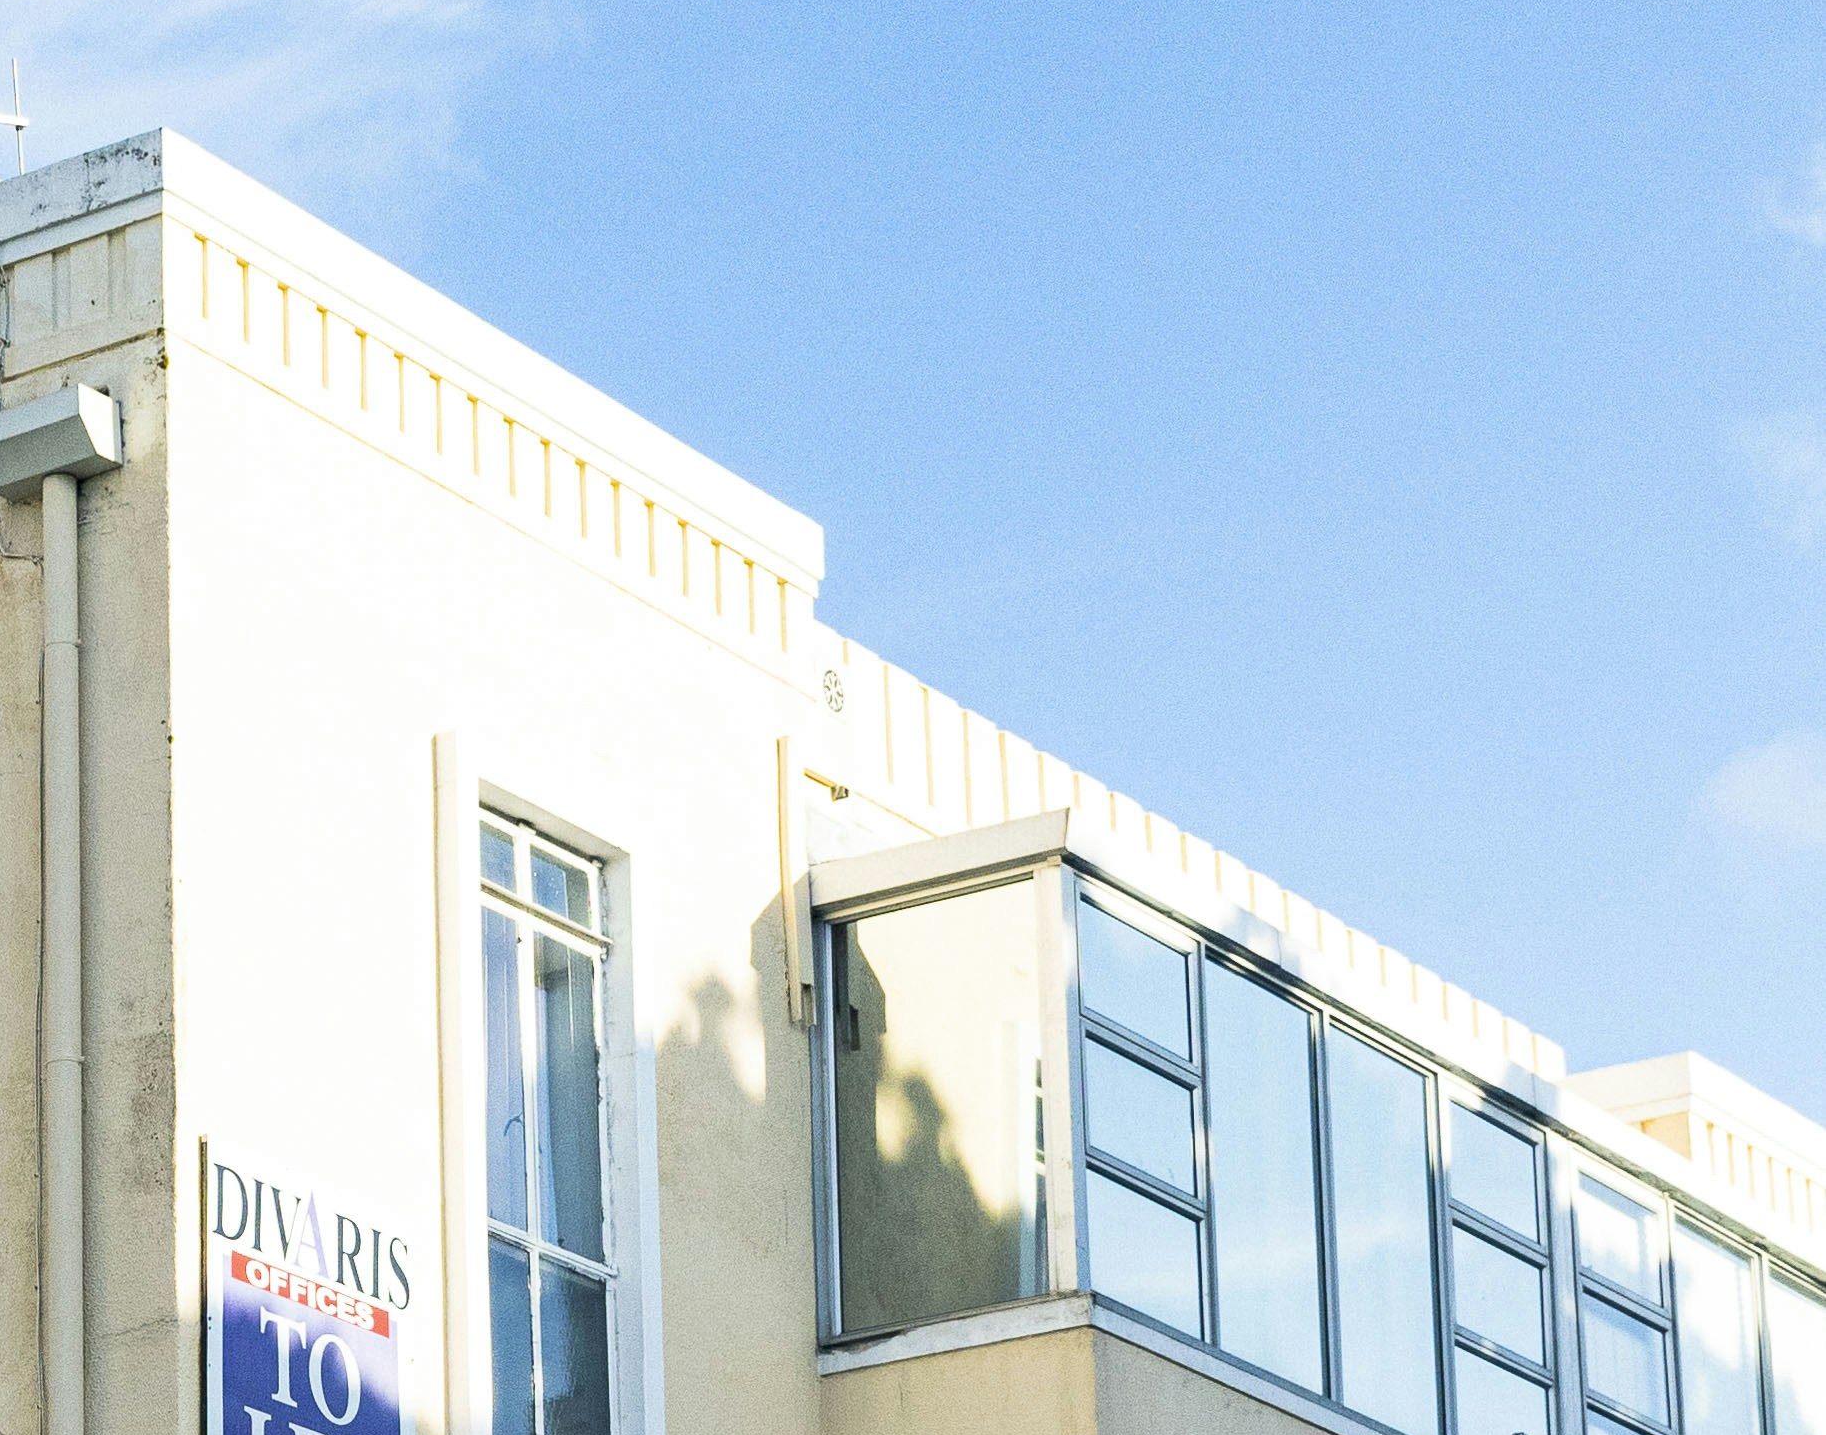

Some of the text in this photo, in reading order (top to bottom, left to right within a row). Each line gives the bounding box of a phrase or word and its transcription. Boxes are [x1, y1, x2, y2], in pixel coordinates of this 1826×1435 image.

[212, 1162, 410, 1310] DIVARIS
[245, 1259, 374, 1331] OFFICES
[259, 1305, 361, 1426] TO
